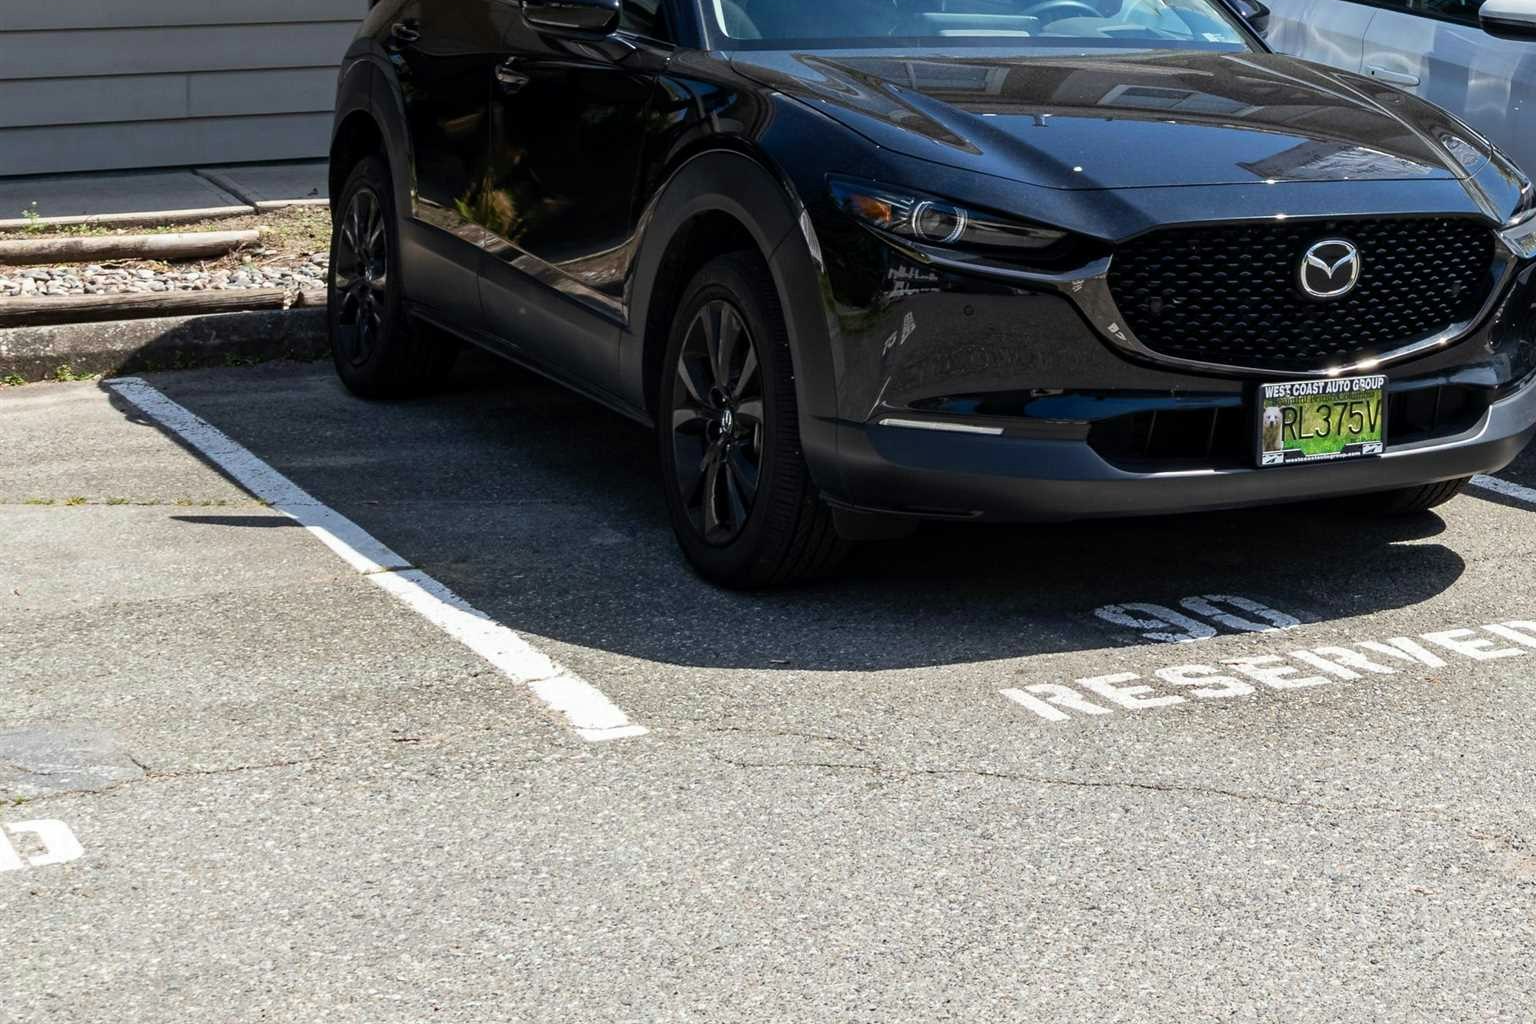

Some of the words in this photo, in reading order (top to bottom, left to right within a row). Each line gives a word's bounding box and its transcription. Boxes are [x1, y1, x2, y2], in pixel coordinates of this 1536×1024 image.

[1264, 385, 1292, 399] WEST
[1292, 382, 1325, 395] COAST
[1325, 379, 1350, 393] AUTO
[1352, 377, 1385, 392] GROUP
[1094, 593, 1301, 644] 90
